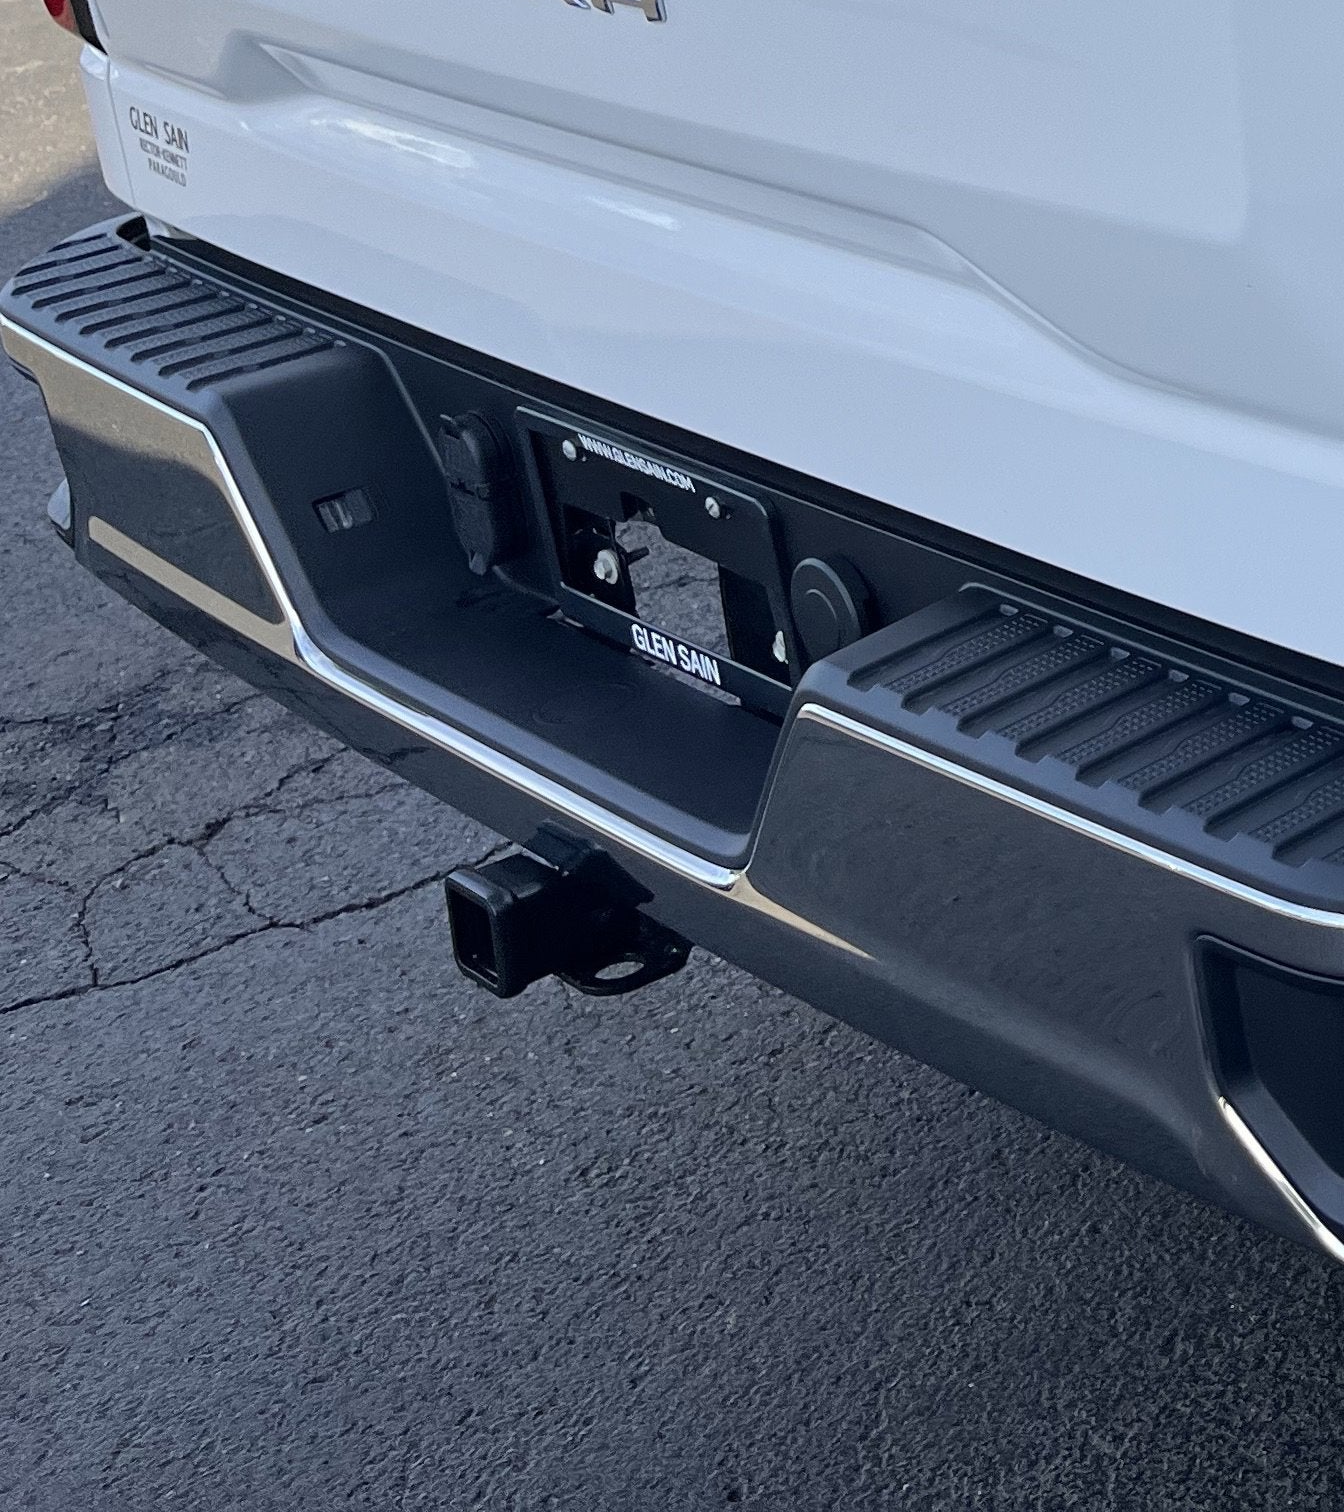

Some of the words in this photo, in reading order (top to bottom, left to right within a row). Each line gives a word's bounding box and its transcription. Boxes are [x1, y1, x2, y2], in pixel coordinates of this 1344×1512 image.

[129, 106, 159, 139] GLEN
[163, 121, 189, 153] SAIN
[578, 433, 695, 493] WWW.GLENSAIN.COM
[631, 623, 678, 666] GLEN
[677, 643, 721, 686] SAIN
